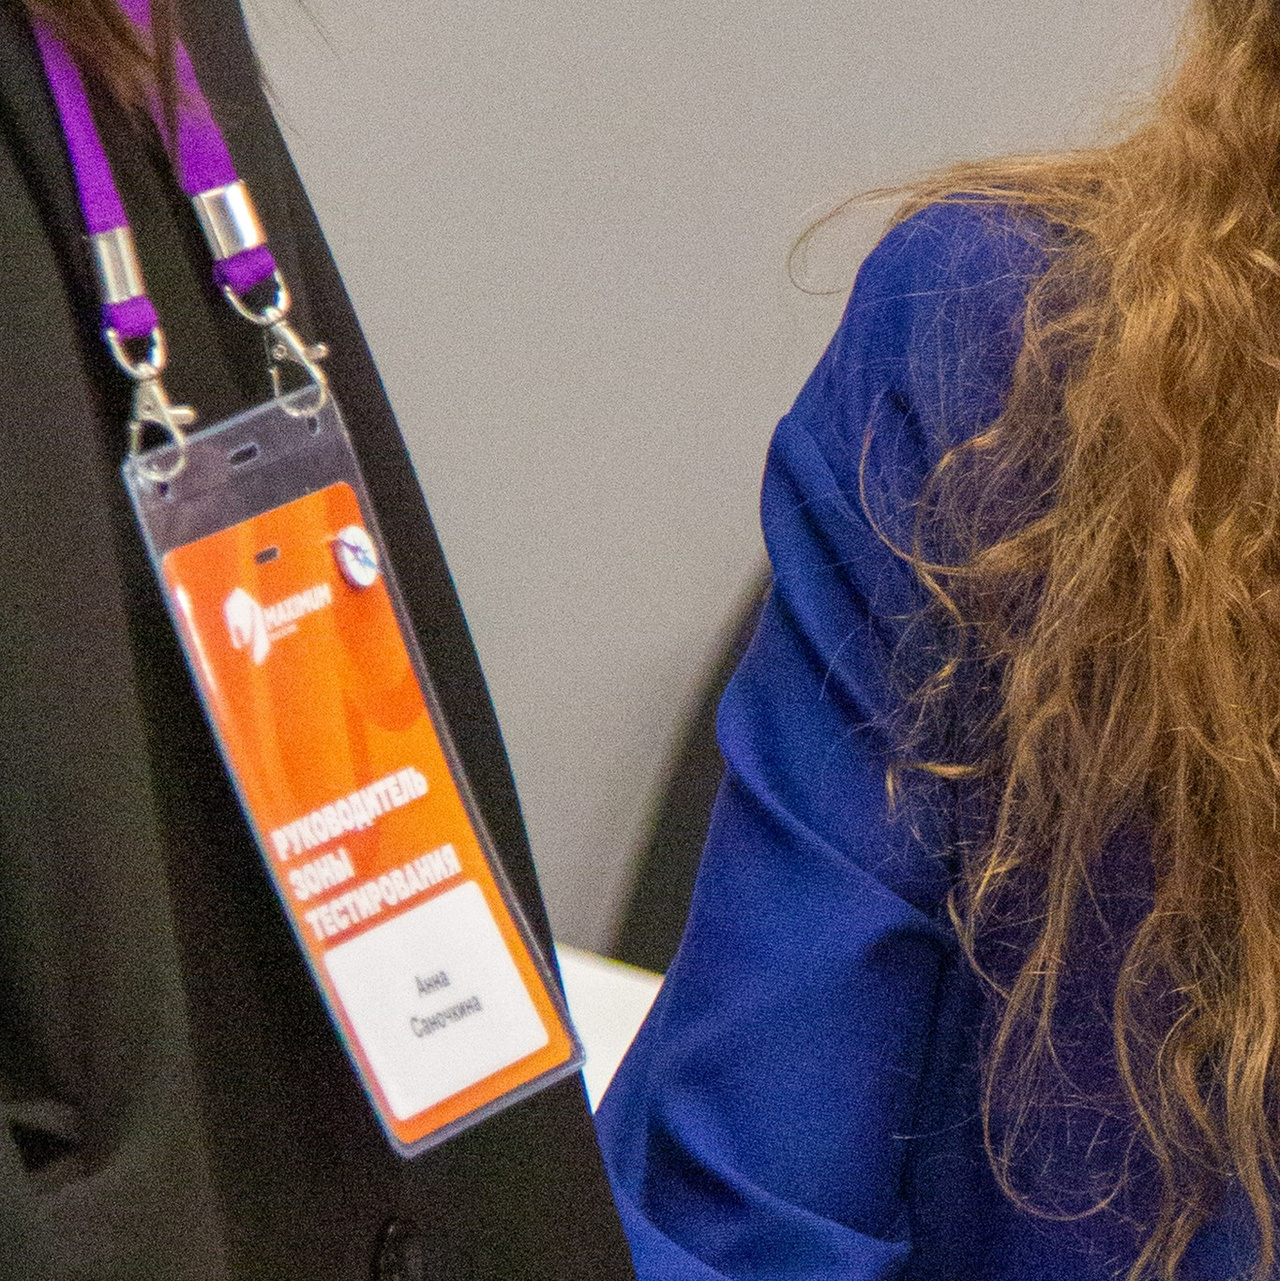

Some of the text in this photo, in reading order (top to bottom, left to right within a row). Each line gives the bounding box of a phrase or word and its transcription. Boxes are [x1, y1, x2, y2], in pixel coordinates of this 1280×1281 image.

[263, 582, 332, 630] MAXIMUM
[271, 766, 429, 862] РУКОВОДИТЕЛЬ
[288, 847, 355, 901] ЗОНЫ
[304, 842, 463, 941] ТЕСТИРОВАНИЯ
